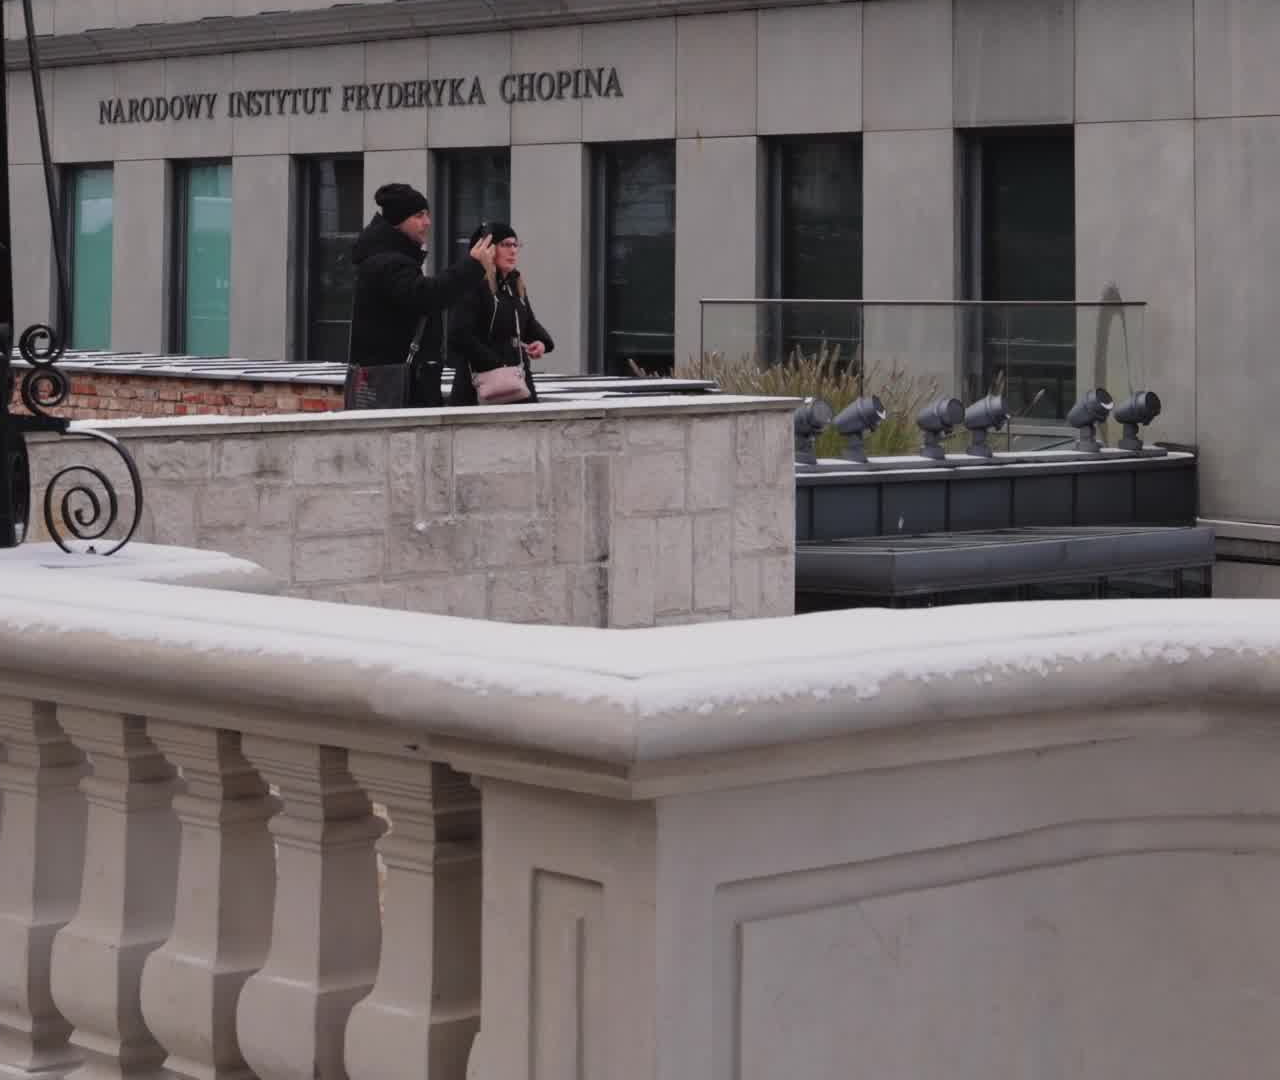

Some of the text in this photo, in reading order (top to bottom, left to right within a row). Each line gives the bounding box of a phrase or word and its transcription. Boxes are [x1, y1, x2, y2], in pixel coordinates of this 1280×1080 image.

[99, 67, 623, 125] NARODOWY INSTYTUT FRYDERYKA CHOPINA
